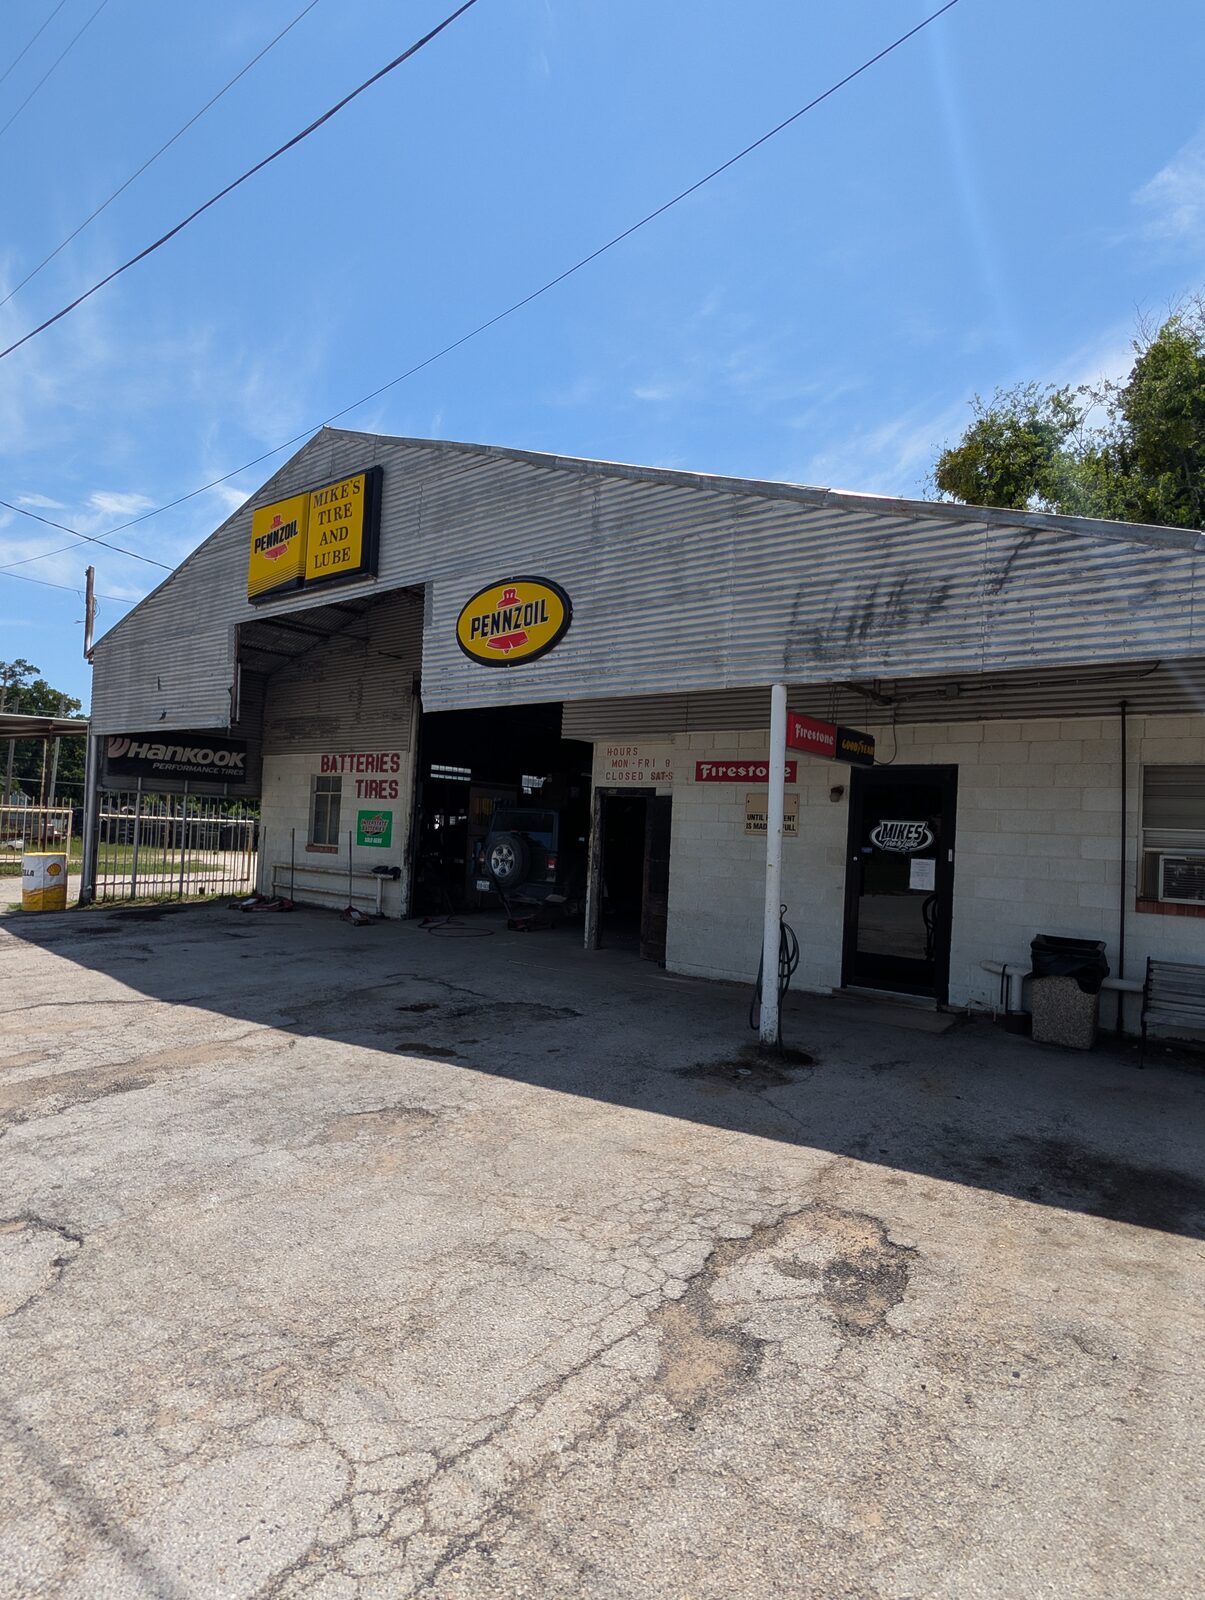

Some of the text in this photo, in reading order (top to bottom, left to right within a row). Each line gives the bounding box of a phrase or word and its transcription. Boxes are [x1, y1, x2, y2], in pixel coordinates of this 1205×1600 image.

[313, 480, 361, 508] MIKE'S
[318, 502, 352, 525] TIRE
[254, 520, 298, 554] PENNZOIL
[320, 526, 349, 546] AND
[314, 547, 351, 569] LUBE
[470, 599, 549, 640] PENNZOIL
[795, 723, 834, 745] Firestone
[607, 747, 638, 756] HOURS
[152, 762, 245, 776] PERFORMANCE TIRES
[320, 753, 400, 773] BATTERIES
[701, 764, 791, 779] Firestoe
[605, 772, 644, 781] CLOSED
[355, 779, 399, 799] TIRES
[766, 814, 795, 822] PENT
[880, 823, 924, 840] MIKES
